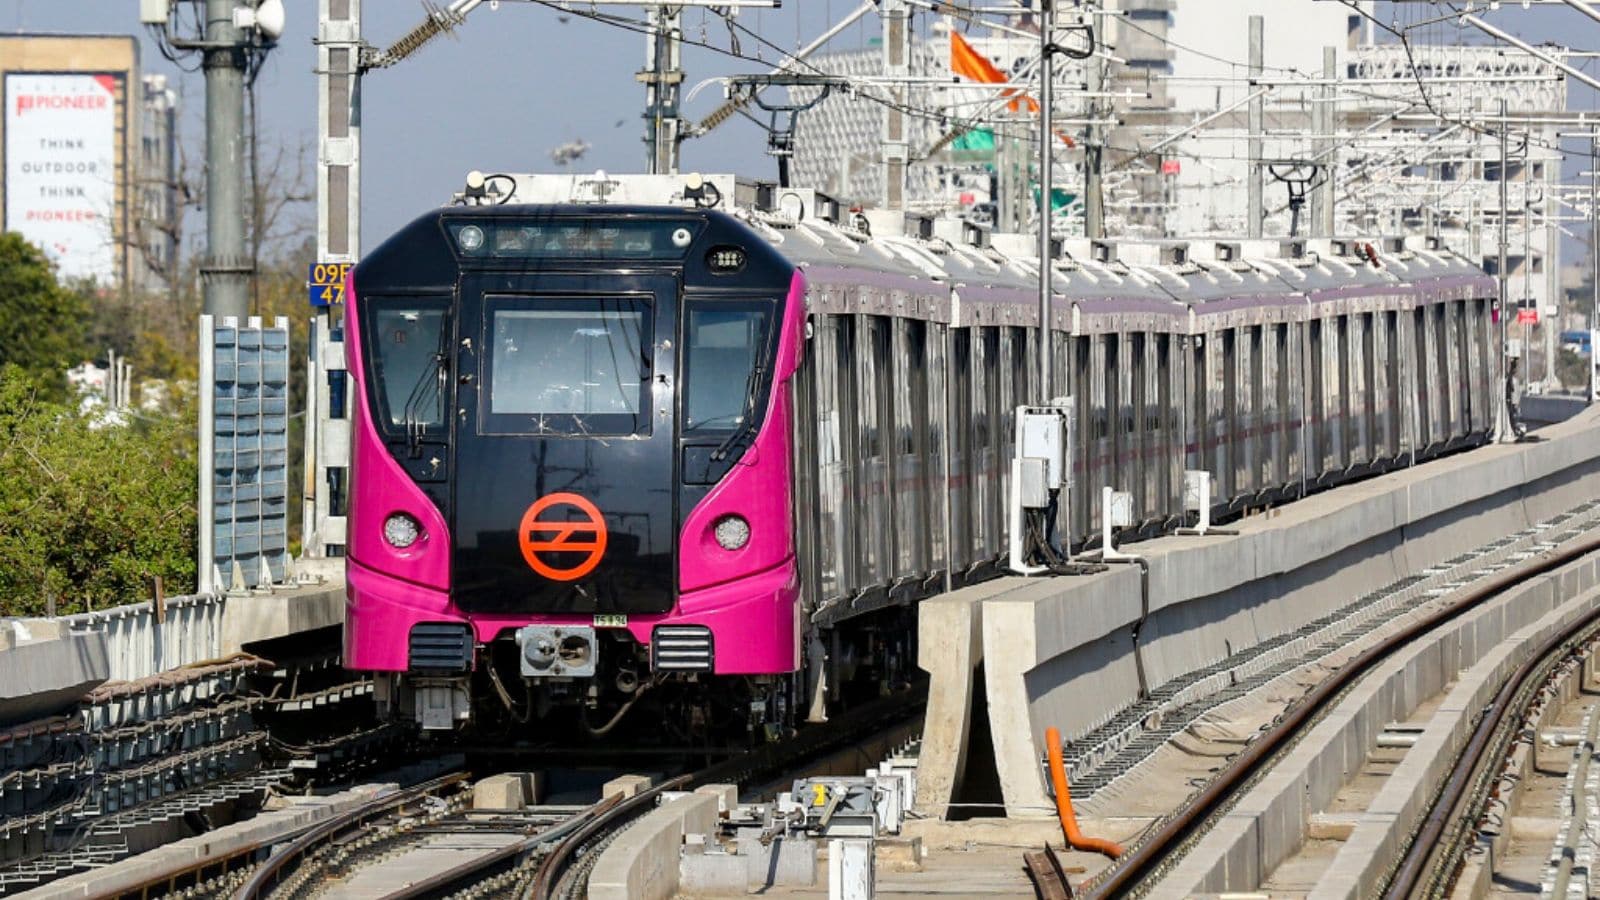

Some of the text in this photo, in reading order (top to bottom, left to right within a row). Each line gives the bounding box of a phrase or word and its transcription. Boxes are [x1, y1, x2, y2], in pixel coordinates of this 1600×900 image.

[36, 95, 106, 109] PIONEER
[40, 138, 84, 149] THINK
[21, 162, 97, 174] OUTDOOR
[40, 186, 84, 197] THINK
[320, 284, 345, 304] 47
